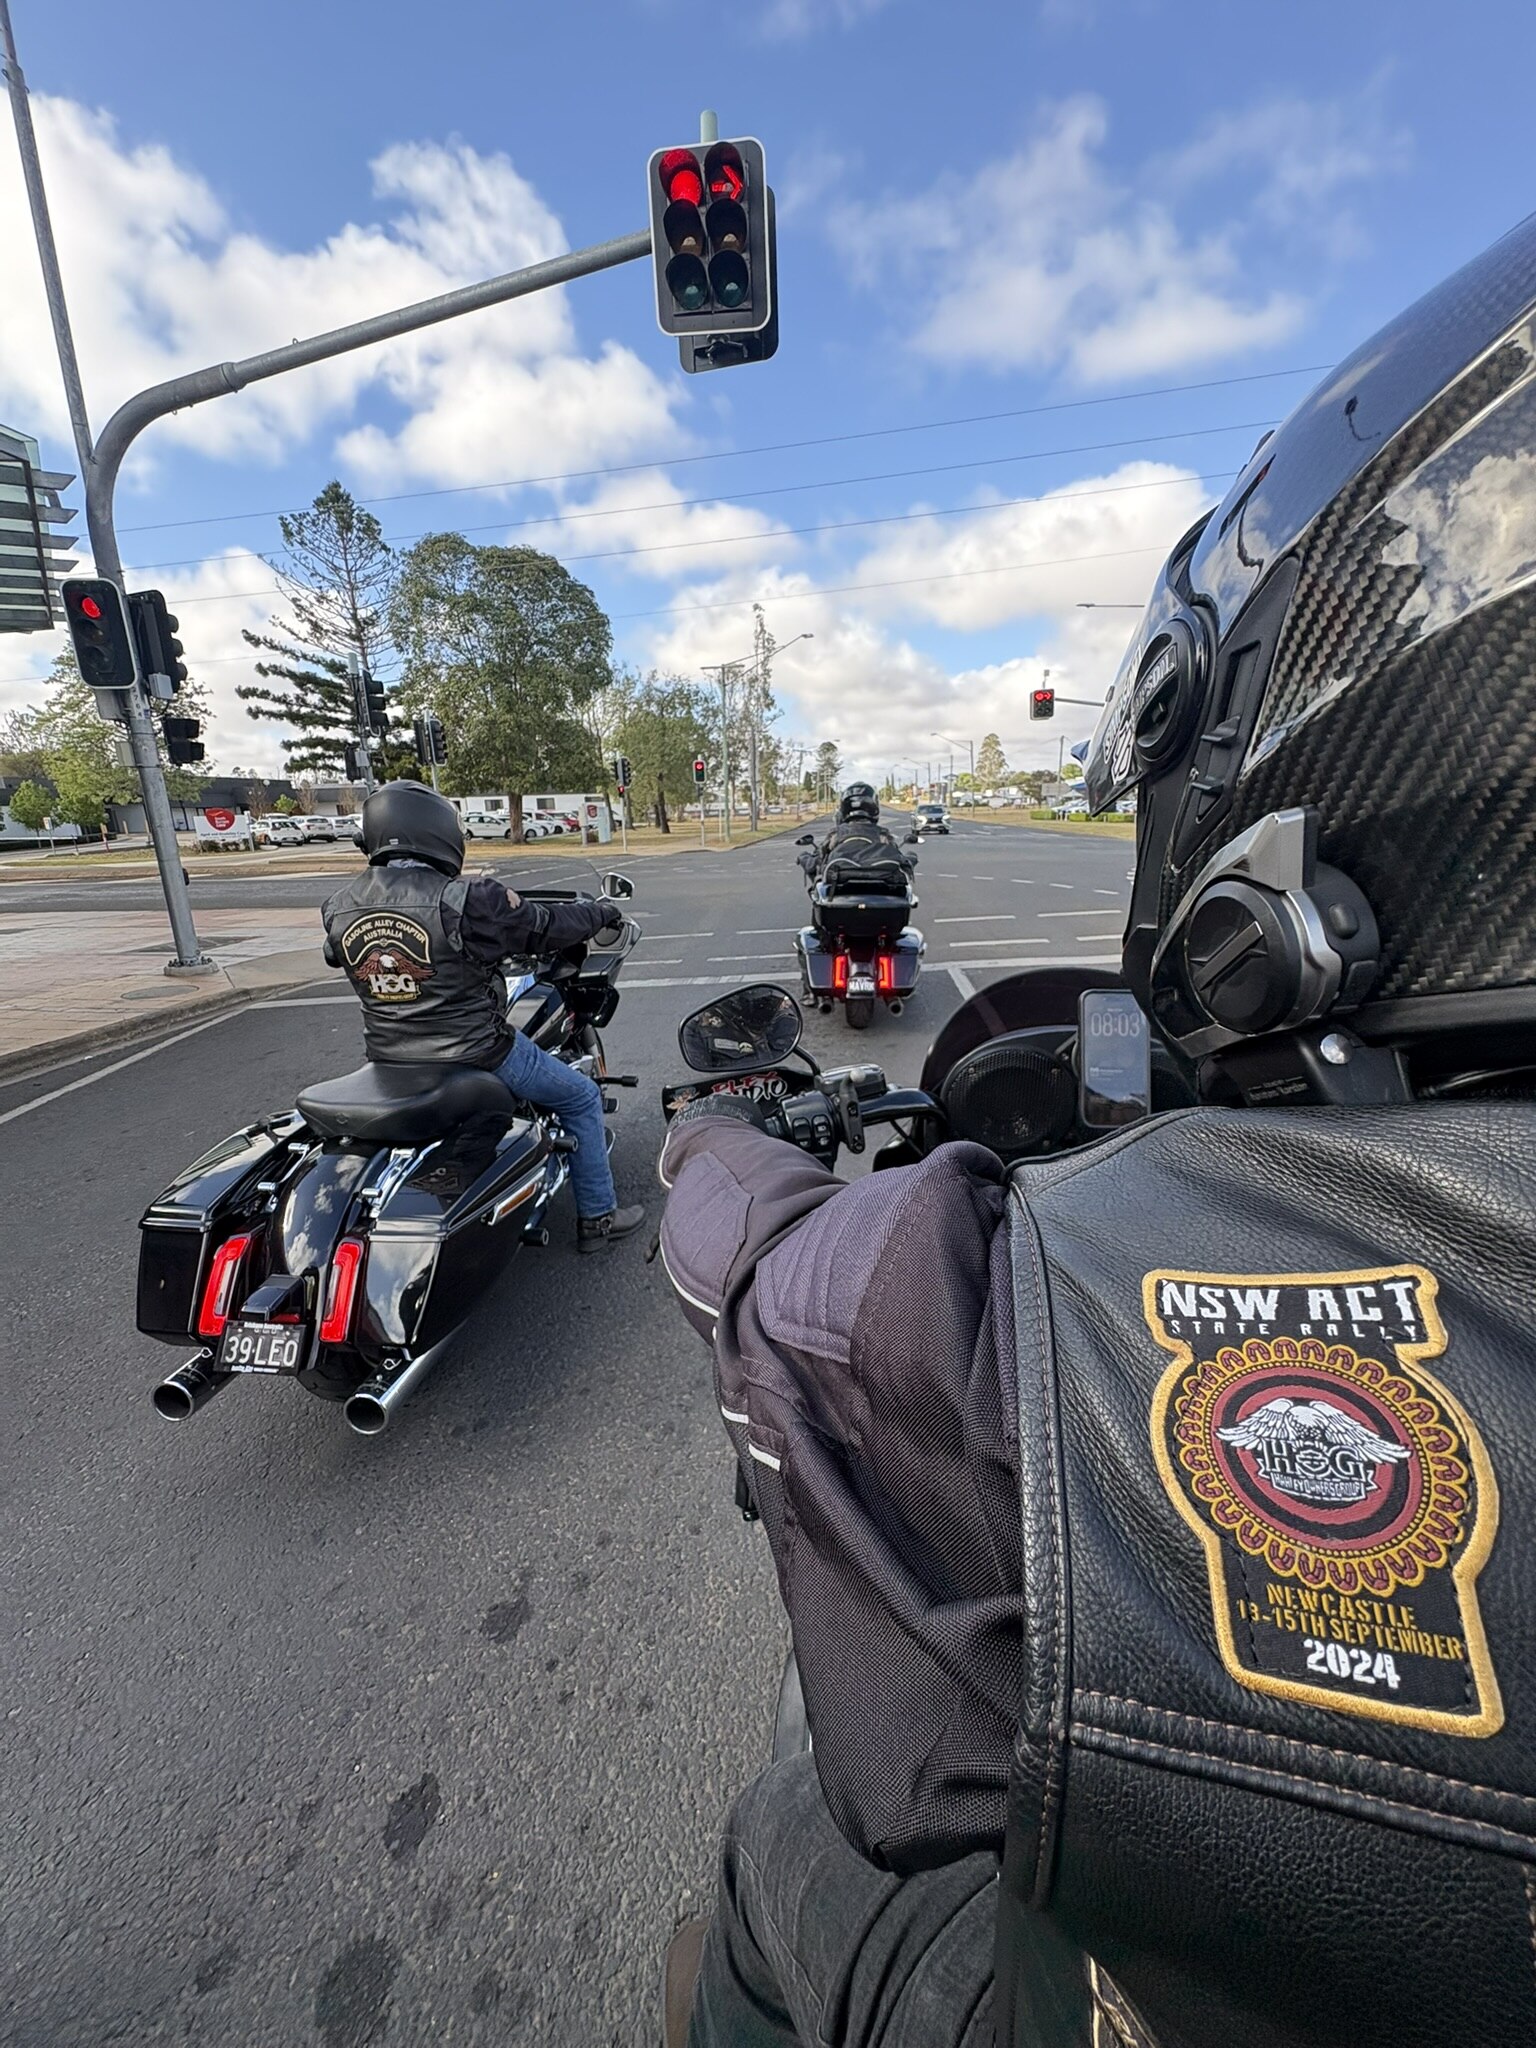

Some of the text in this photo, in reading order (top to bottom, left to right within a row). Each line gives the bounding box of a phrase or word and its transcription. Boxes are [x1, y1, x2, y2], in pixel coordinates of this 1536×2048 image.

[344, 919, 426, 947] GASOLINE ALLEY CHAPTER
[363, 928, 403, 943] AUSTRALIA
[1091, 1012, 1140, 1037] 08:03
[1162, 1281, 1416, 1321] NSW ACT
[1171, 1320, 1417, 1341] STATE RALLY
[1266, 1582, 1418, 1630] NEWCASTLE
[1236, 1598, 1464, 1661] 13-15TH SEPTEMBER
[1303, 1638, 1401, 1689] 2024
